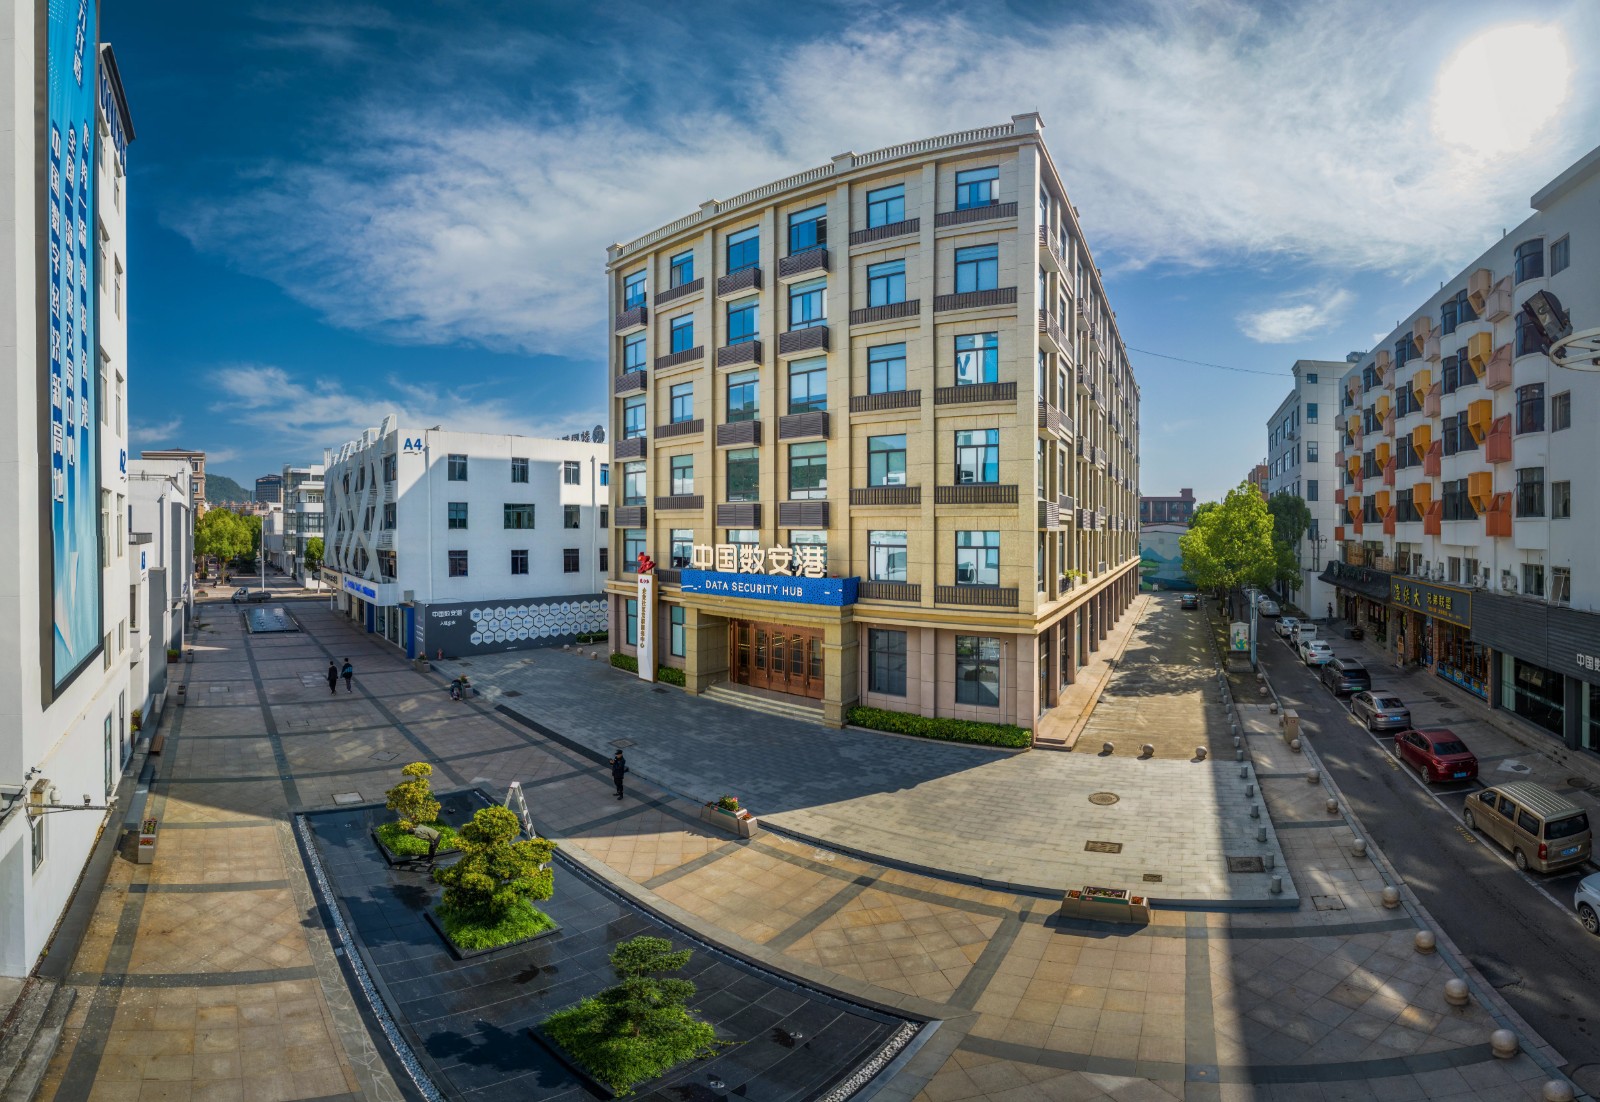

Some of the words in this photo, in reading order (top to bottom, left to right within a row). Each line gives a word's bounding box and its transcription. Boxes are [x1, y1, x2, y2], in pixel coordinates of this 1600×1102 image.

[51, 127, 64, 503] 中国数字经济新高地
[403, 438, 422, 450] A4
[693, 543, 825, 578] 中国数安港
[705, 579, 729, 590] DATA
[731, 581, 778, 595] SECURITY
[782, 586, 803, 597] HUB
[1427, 592, 1452, 610] 兄弟联盟
